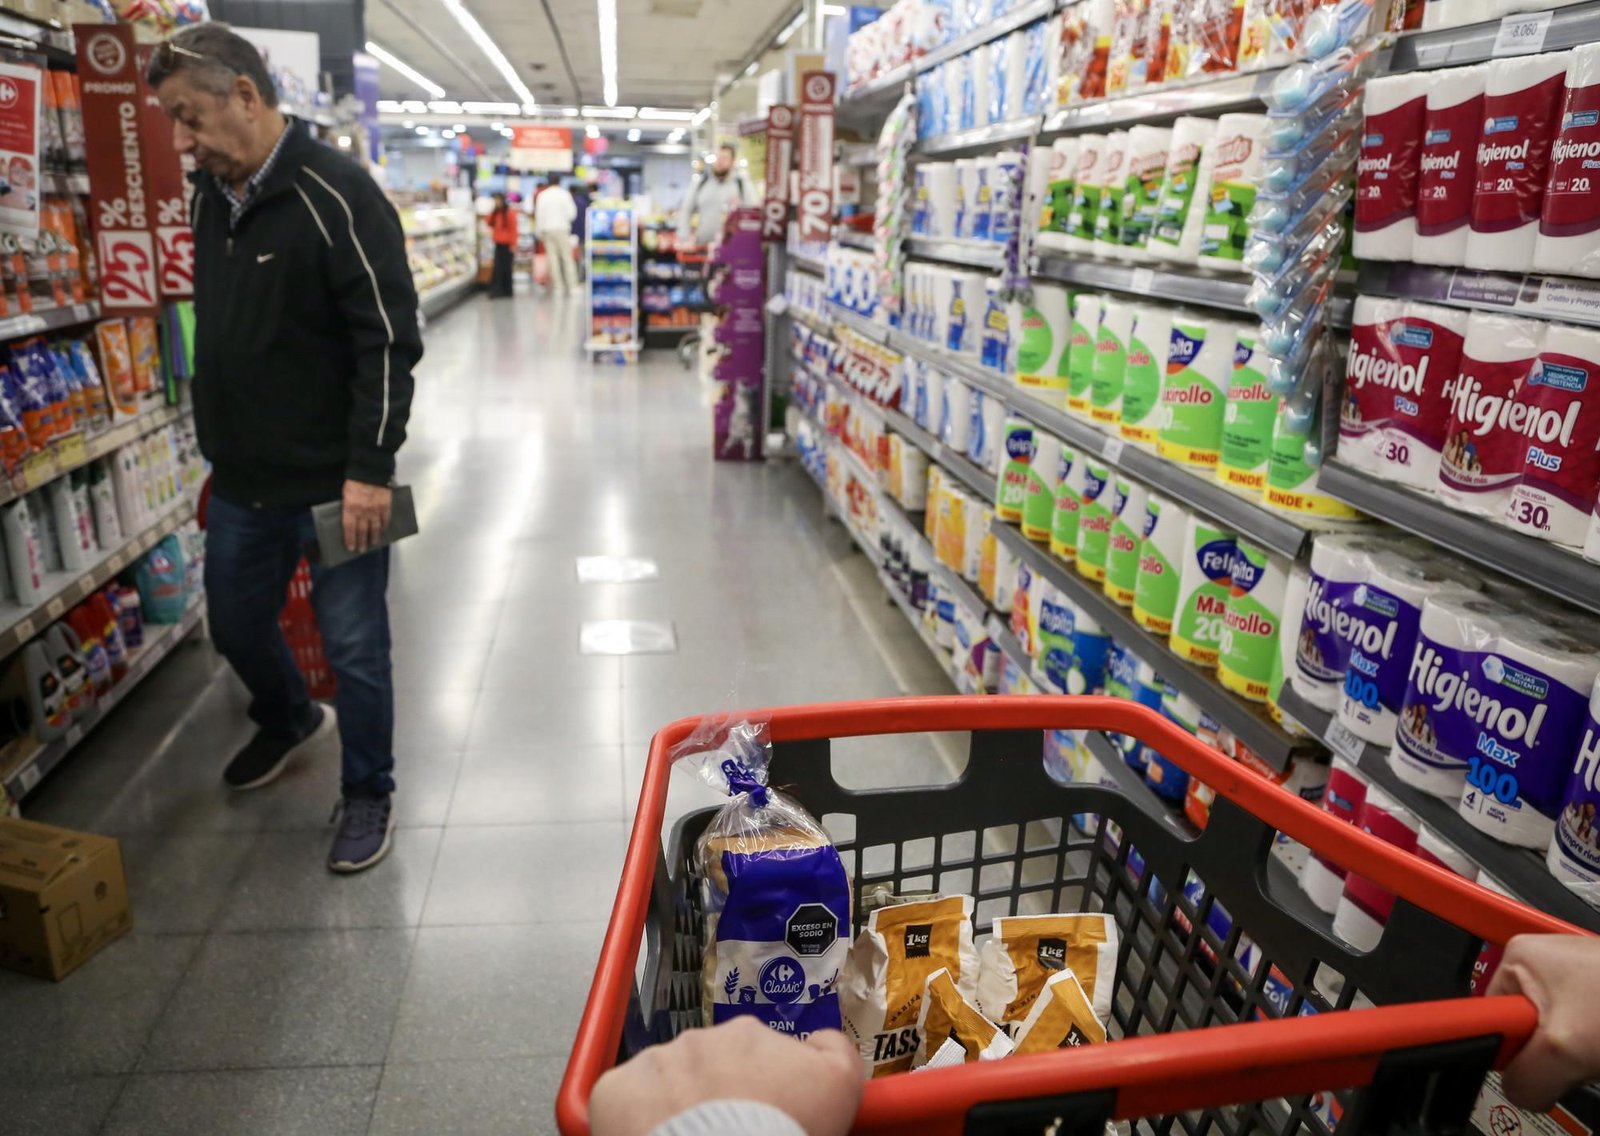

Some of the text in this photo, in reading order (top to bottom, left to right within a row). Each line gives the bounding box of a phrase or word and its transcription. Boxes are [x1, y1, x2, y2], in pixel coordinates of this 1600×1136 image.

[1550, 139, 1600, 165] Higieno
[118, 101, 147, 228] DESCUENTO
[802, 191, 830, 235] 70
[102, 232, 153, 304] 25
[1394, 395, 1418, 416] Plus
[1450, 372, 1582, 448] Higienol
[1189, 451, 1219, 464] RIND
[1525, 446, 1562, 472] Plus
[1228, 470, 1263, 487] RINDE
[1268, 489, 1305, 509] RINDE
[1306, 576, 1398, 661] Higienol
[1349, 647, 1380, 677] Max
[1246, 682, 1268, 697] RIN
[1409, 641, 1548, 749] Higienol
[1475, 731, 1521, 769] Max
[1466, 791, 1476, 804] 4
[791, 923, 821, 932] EXCESO
[799, 930, 824, 938] SODIO
[906, 934, 929, 946] 1kg
[1039, 946, 1064, 958] 1kg
[769, 1020, 795, 1032] PAN
